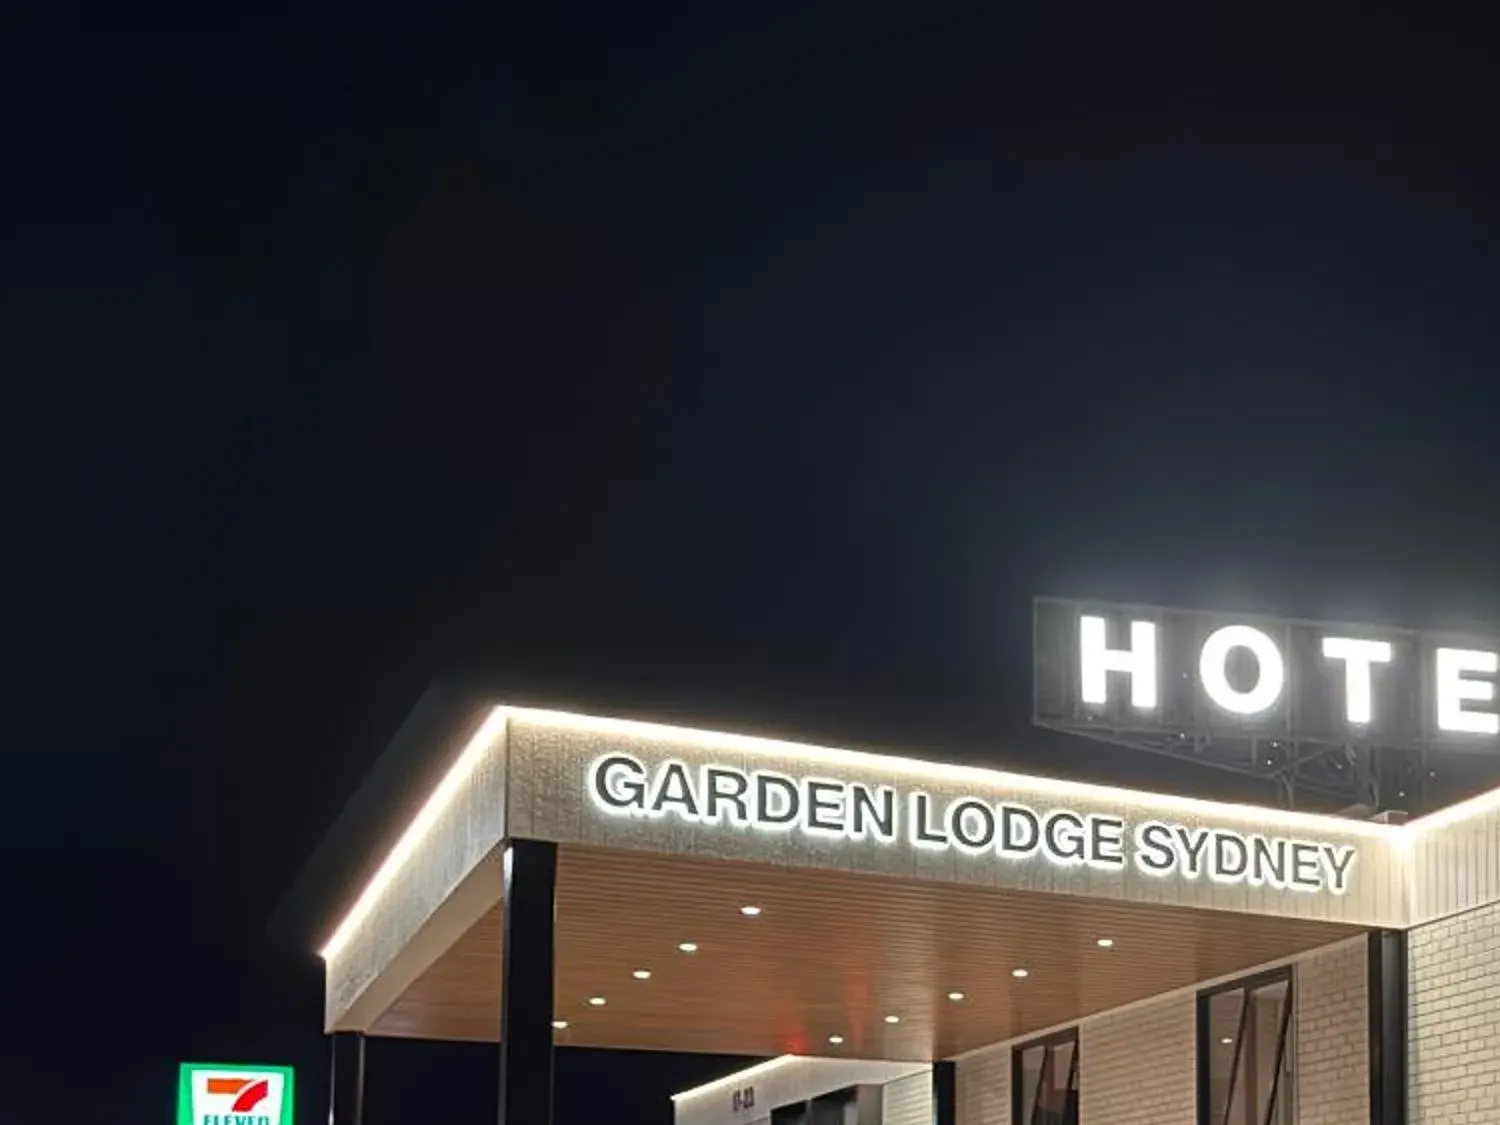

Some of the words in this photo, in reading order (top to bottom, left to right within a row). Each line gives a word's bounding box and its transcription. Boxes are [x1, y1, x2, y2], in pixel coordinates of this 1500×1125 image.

[594, 755, 895, 838] GARDEN
[915, 793, 1124, 866] LODGE
[1139, 822, 1356, 890] SYDNEY
